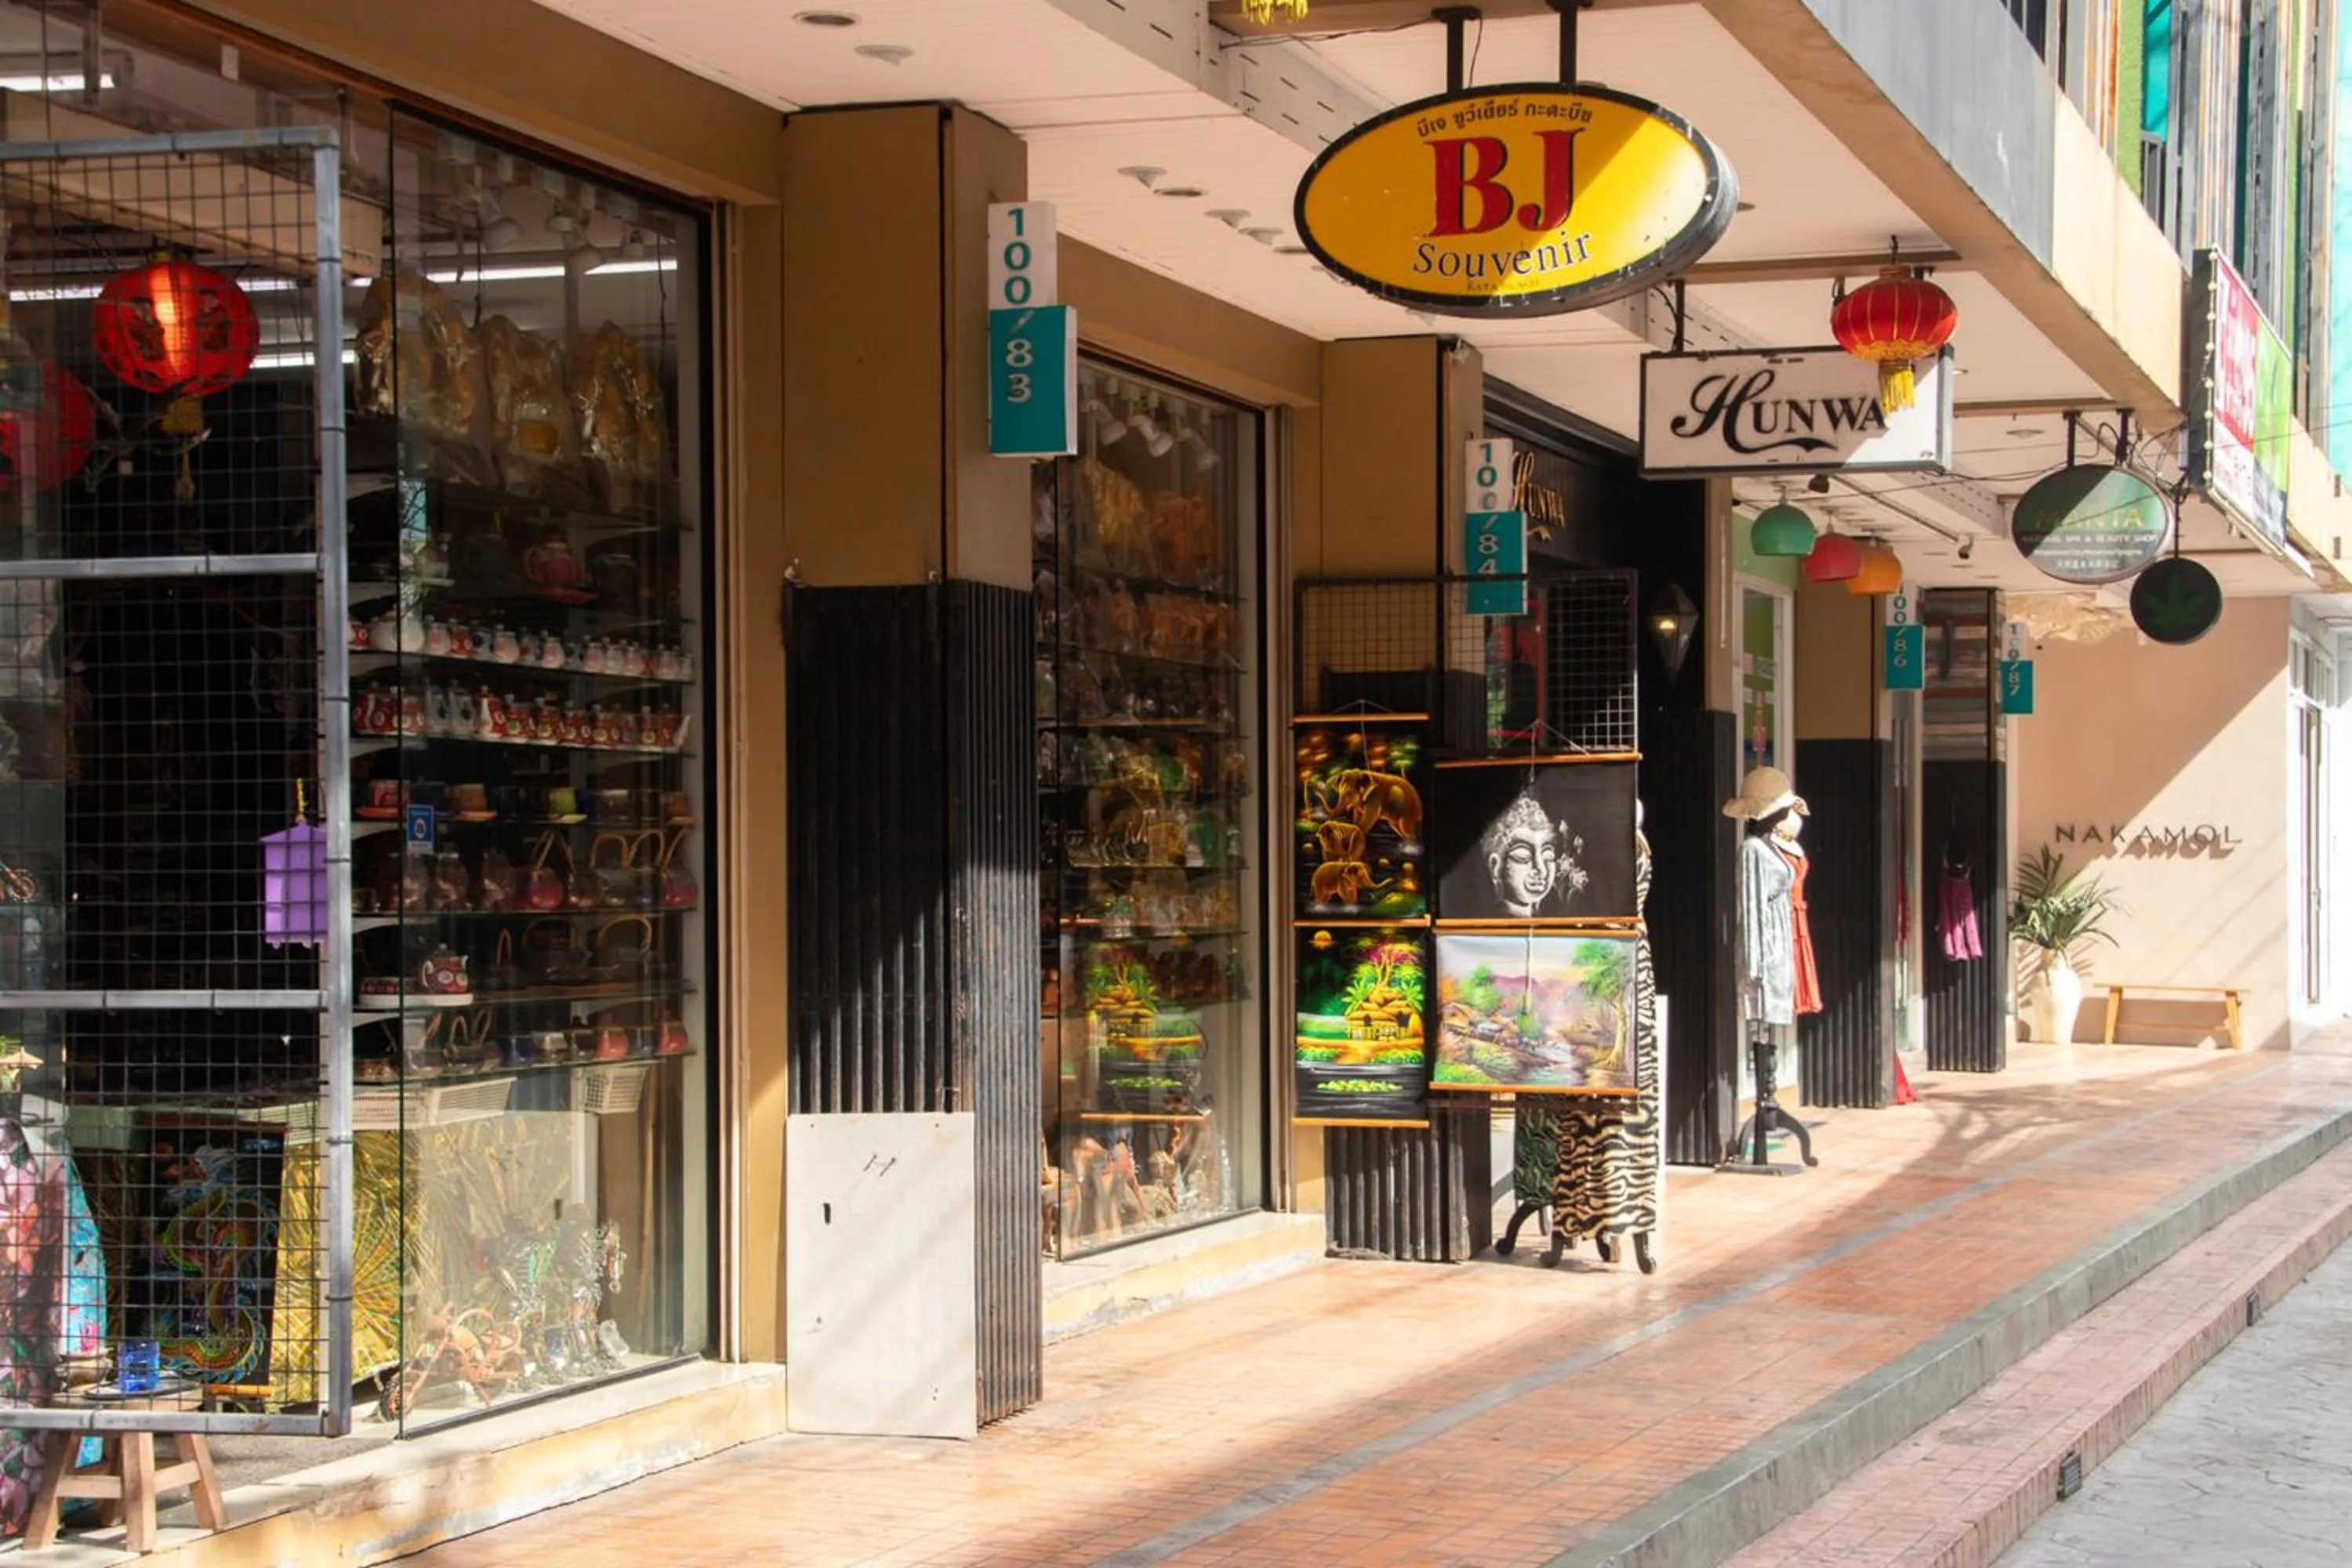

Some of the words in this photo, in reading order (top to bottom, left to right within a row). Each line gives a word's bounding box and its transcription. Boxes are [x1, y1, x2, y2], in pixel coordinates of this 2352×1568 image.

[1424, 128, 1585, 238] BJ
[1413, 230, 1590, 278] Souvenir
[1004, 207, 1034, 403] 100/83
[2056, 824, 2242, 844] NAKAMOL
